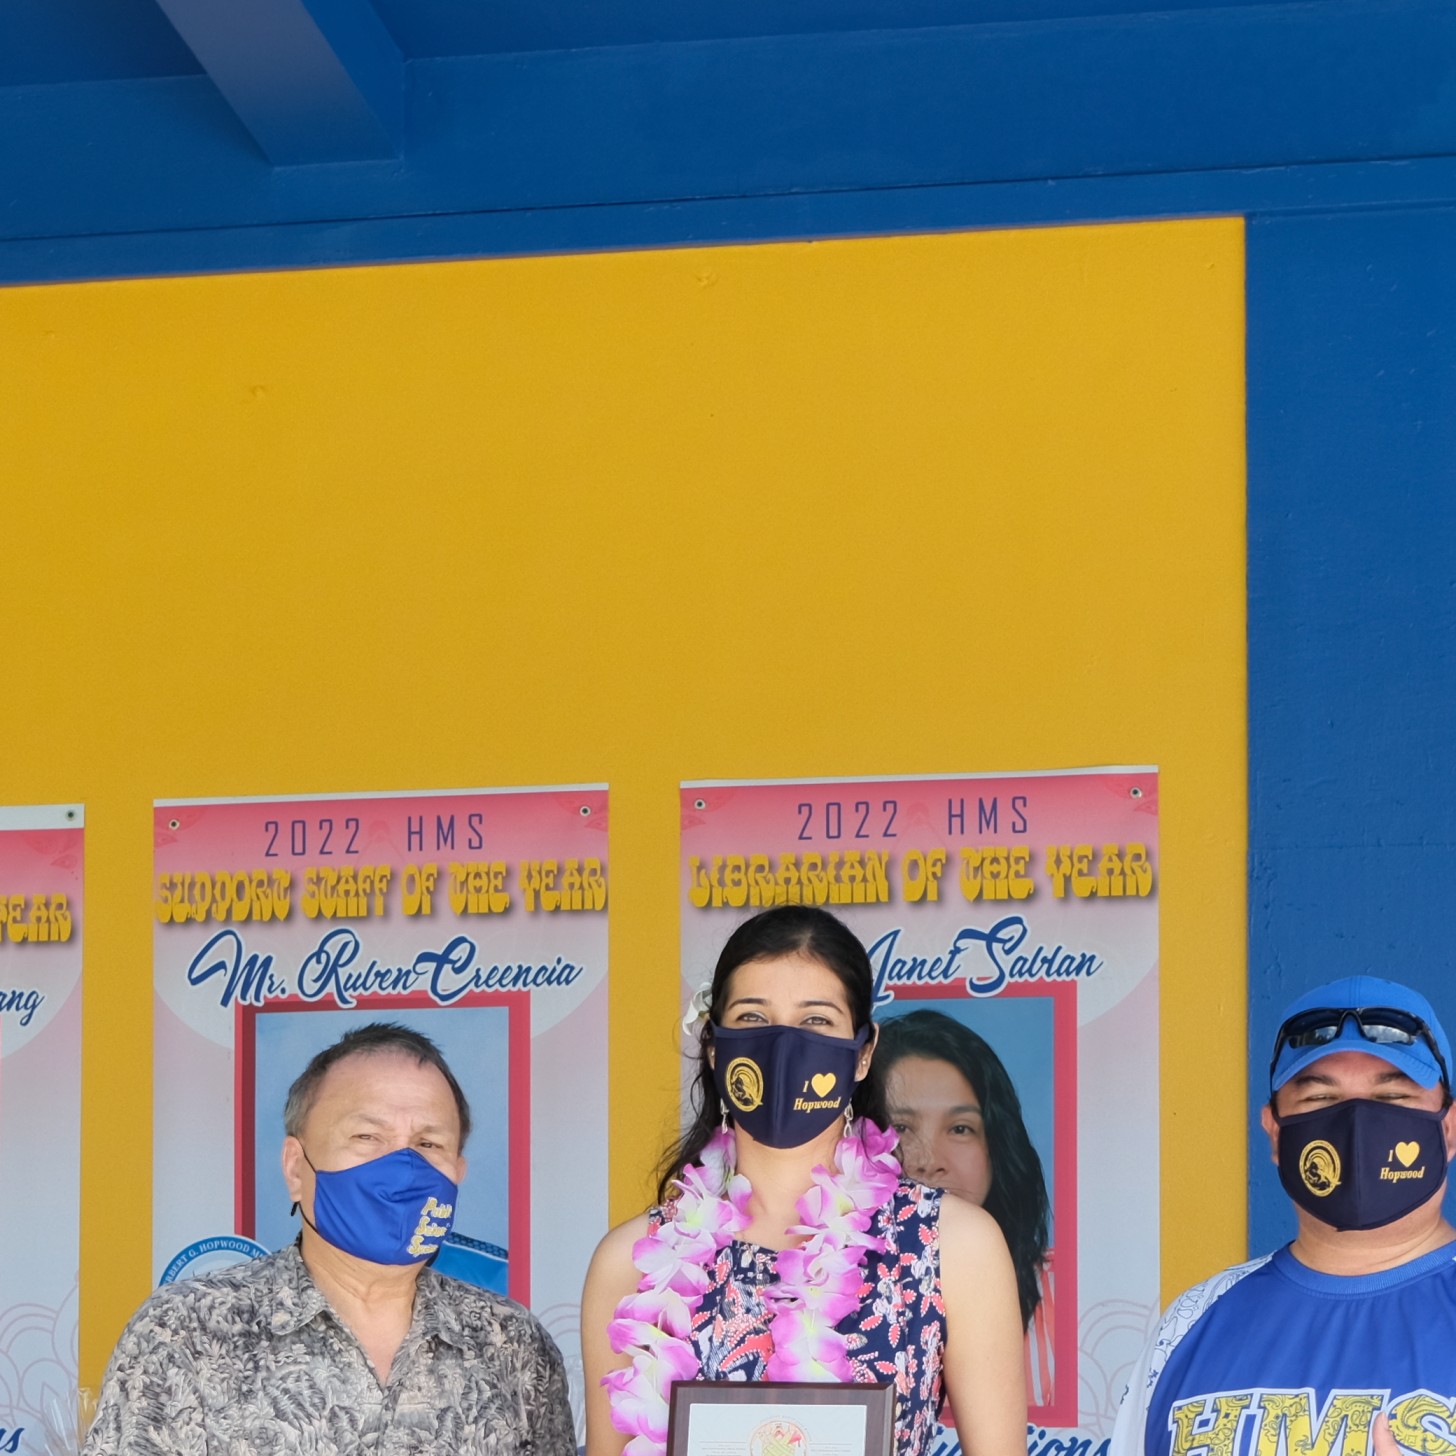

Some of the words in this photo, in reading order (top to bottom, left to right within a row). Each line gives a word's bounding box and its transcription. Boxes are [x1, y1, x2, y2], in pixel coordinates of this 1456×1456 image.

[265, 818, 360, 857] 2022
[407, 814, 484, 851] HMS
[798, 800, 898, 840] 2022
[948, 796, 1028, 835] HMS
[156, 868, 291, 923] SUPPORT
[301, 864, 391, 918] STAFF
[401, 862, 439, 916] OF
[449, 860, 509, 916] THE
[518, 857, 607, 912] YEAR
[688, 851, 889, 908] LIBRARIAN
[901, 848, 947, 903] OF
[960, 845, 1033, 902] THE
[1046, 843, 1153, 898] YEAR
[189, 930, 286, 1007] Mr.
[299, 929, 417, 1006] Ruben
[414, 937, 583, 1003] Creencia
[872, 929, 960, 1001] Janet
[955, 916, 1103, 993] Sablan
[794, 1097, 841, 1113] Hopwood
[803, 1081, 809, 1092] I
[1380, 1166, 1425, 1183] Hopwood
[1388, 1150, 1393, 1162] I
[199, 1241, 249, 1252] HOPWOOD
